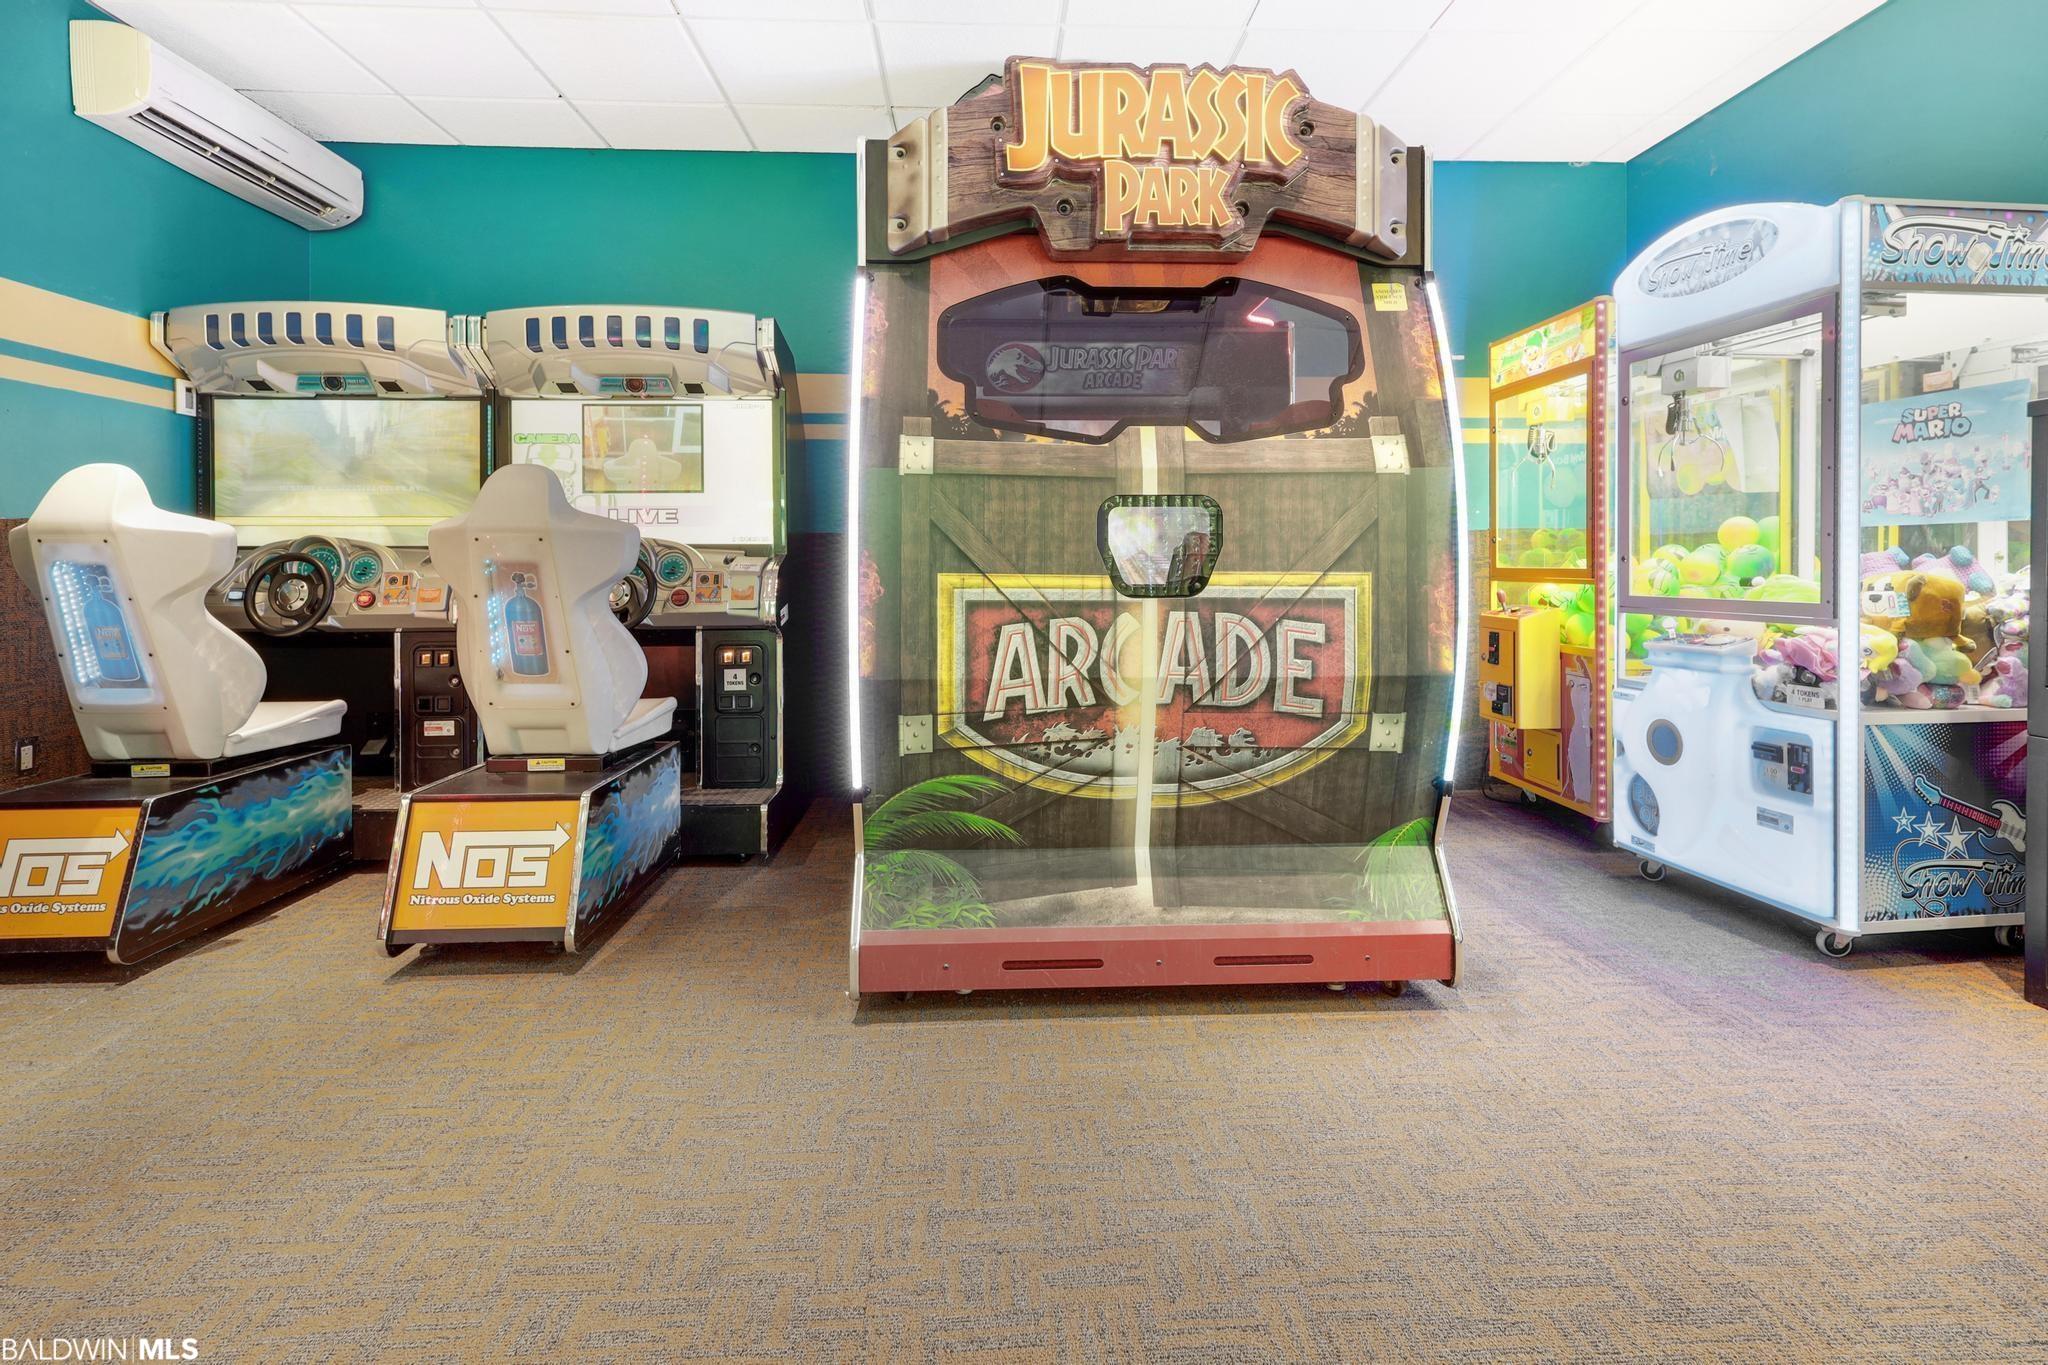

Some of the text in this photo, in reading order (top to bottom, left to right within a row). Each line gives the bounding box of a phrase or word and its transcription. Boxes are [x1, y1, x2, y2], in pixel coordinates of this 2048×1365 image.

[1006, 63, 1302, 172] JURASSIC
[1103, 159, 1233, 231] PARK
[1986, 222, 2048, 271] Tim
[1046, 345, 1135, 373] JURASSIC
[1082, 371, 1143, 390] ARCADE
[1901, 401, 1963, 424] SUPER
[1891, 416, 1973, 444] MARIO
[607, 507, 679, 525] LIVE
[983, 611, 1327, 722] ARCADE
[1796, 689, 1820, 699] TOKENS
[412, 821, 571, 890] NOS
[10, 902, 49, 914] Oxide
[51, 902, 107, 914] Systems
[408, 893, 556, 906] Nitrous Oxide Systems
